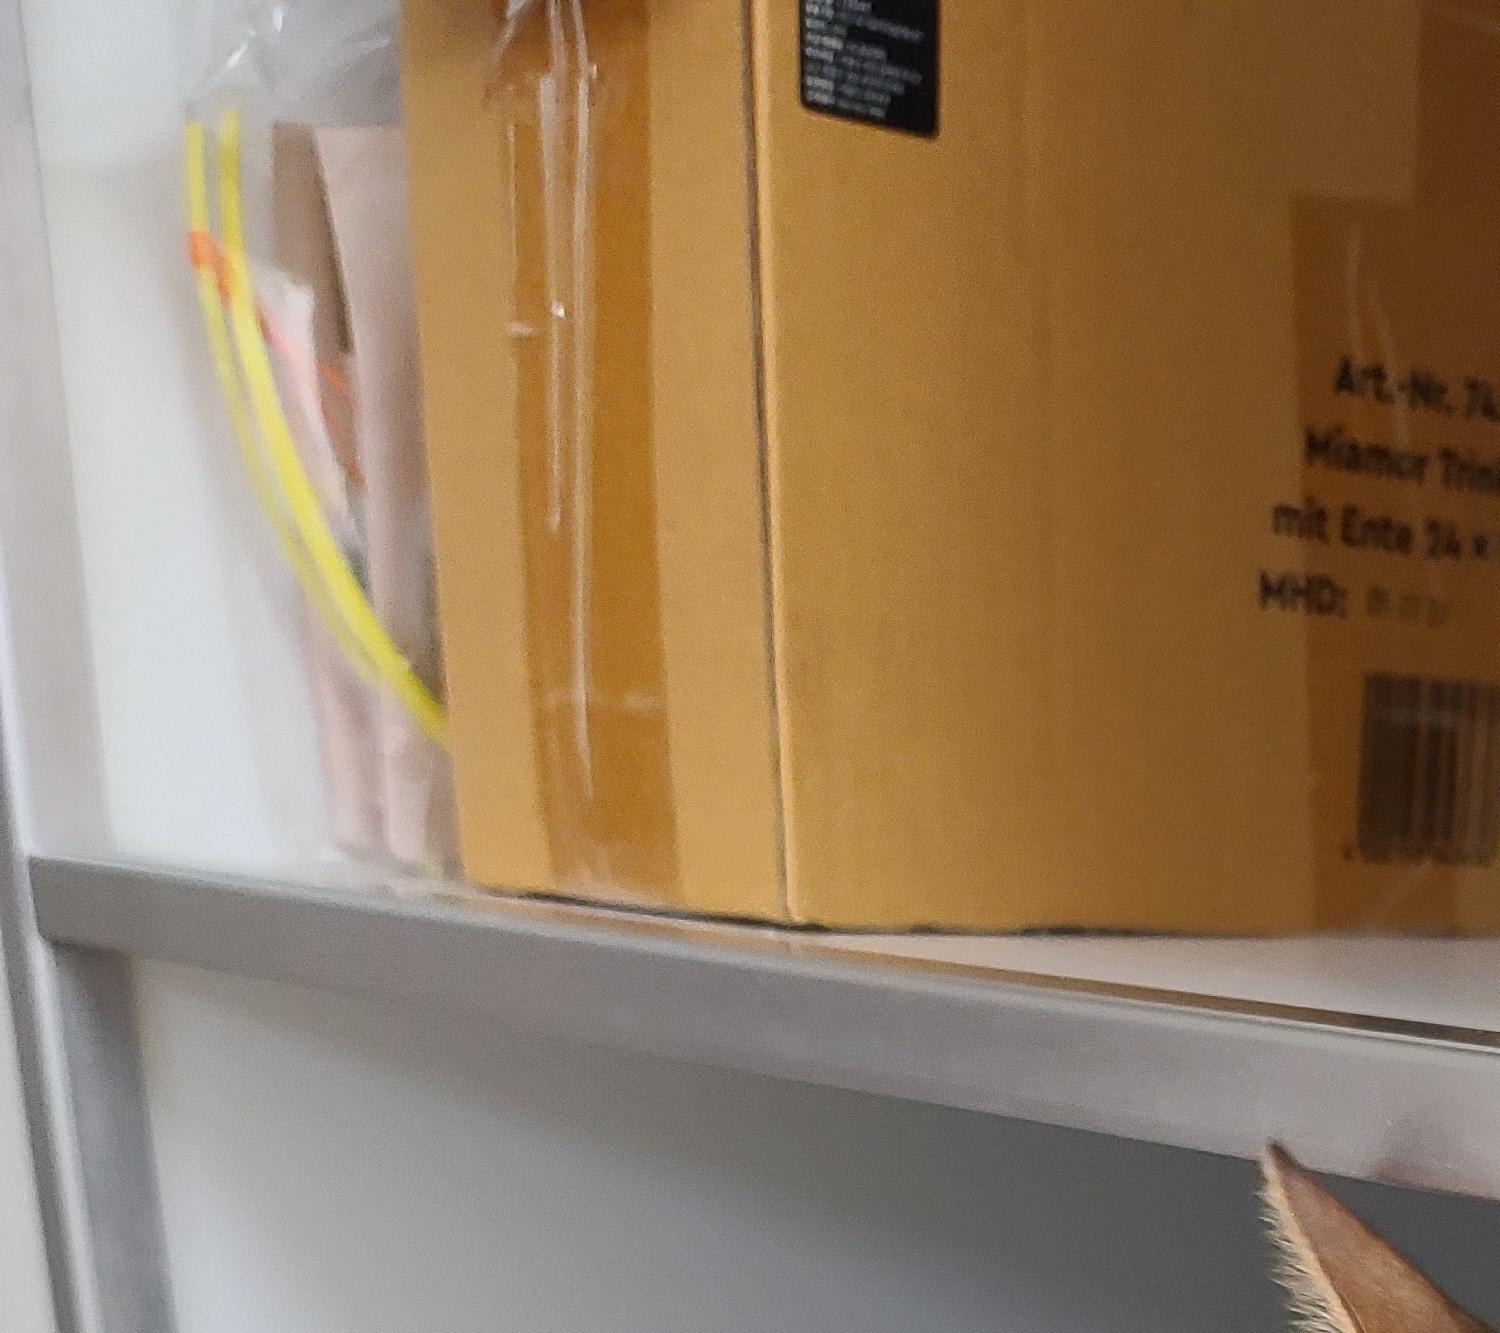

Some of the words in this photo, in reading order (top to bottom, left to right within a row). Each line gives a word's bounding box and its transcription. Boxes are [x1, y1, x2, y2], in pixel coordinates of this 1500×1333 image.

[1304, 425, 1428, 482] Miamor
[1272, 496, 1330, 545] mit
[1341, 504, 1413, 554] Ente
[1425, 517, 1461, 560] 24
[1257, 568, 1347, 619] MHD:
